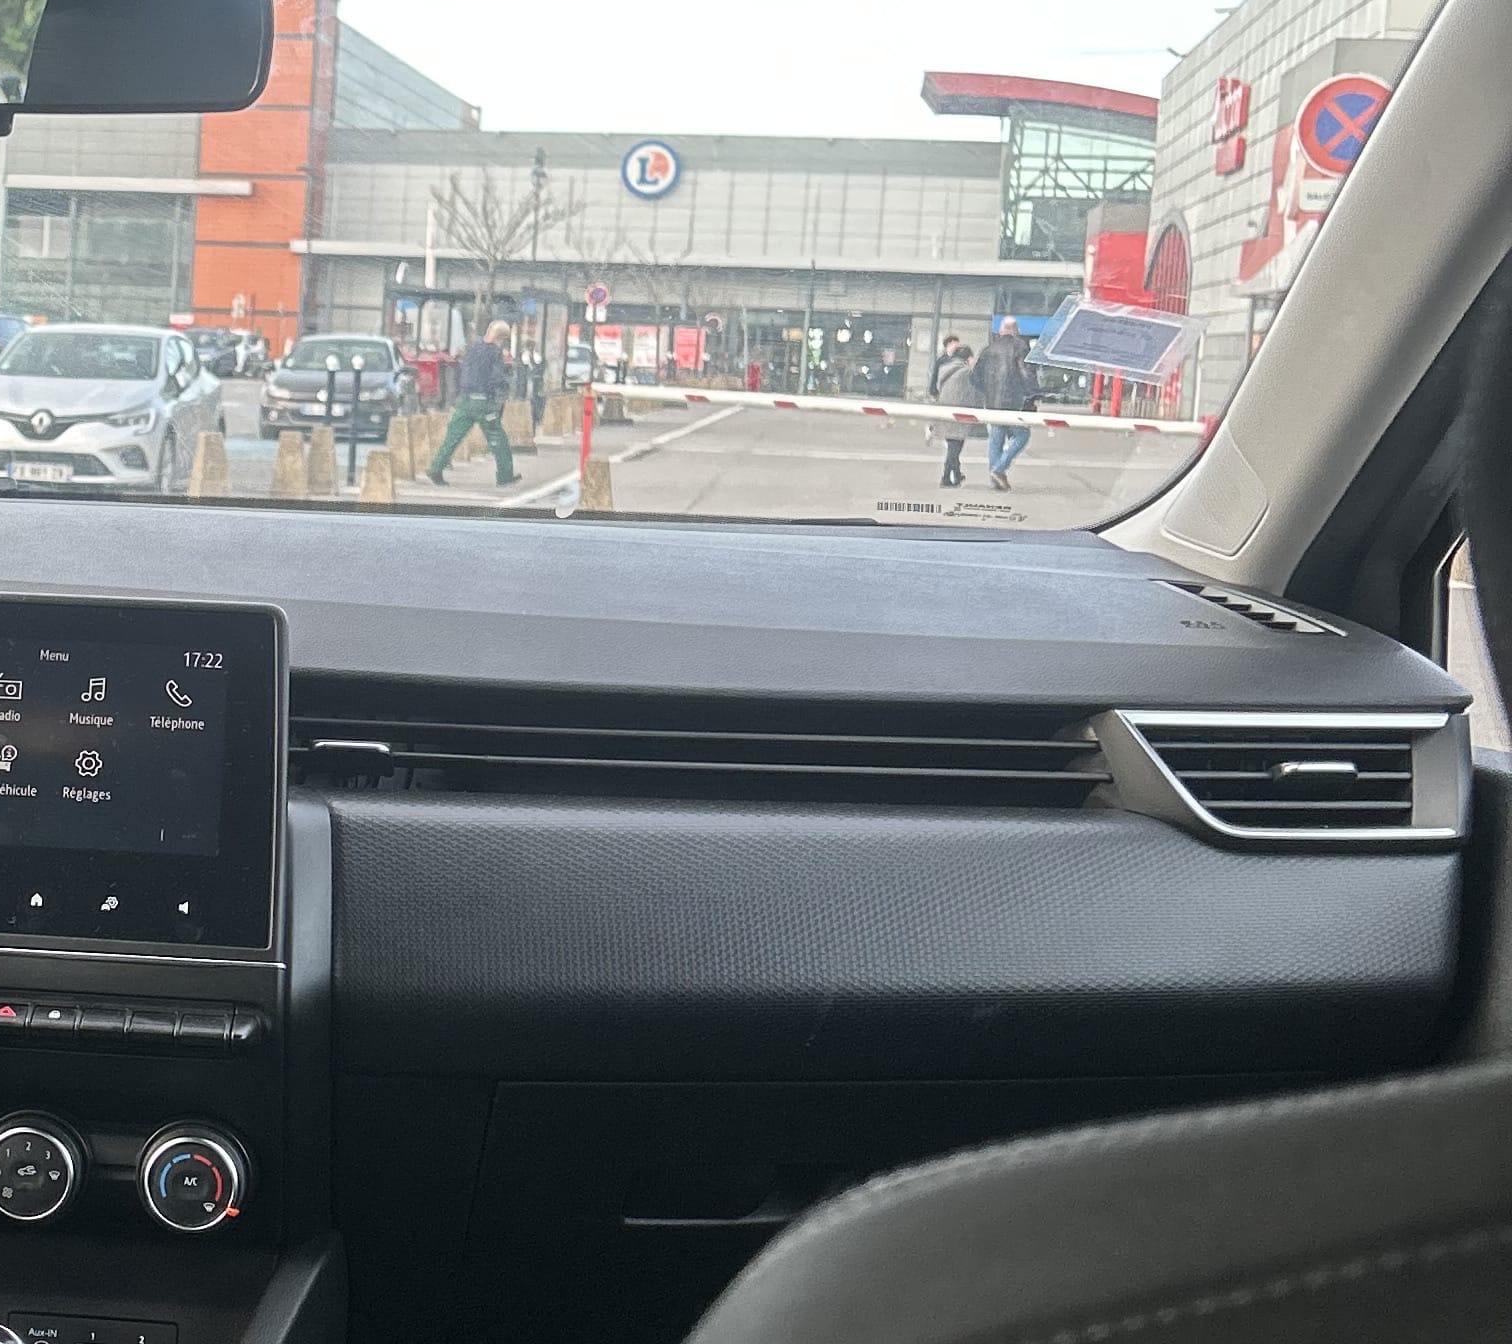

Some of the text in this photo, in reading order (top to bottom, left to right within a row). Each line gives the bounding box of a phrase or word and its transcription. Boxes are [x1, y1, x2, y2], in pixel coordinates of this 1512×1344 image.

[39, 649, 69, 663] Menu
[183, 651, 224, 669] 17:22
[69, 713, 114, 729] Musique
[150, 716, 205, 732] Téléphone
[62, 786, 112, 803] Réglages
[183, 1175, 198, 1188] A/C
